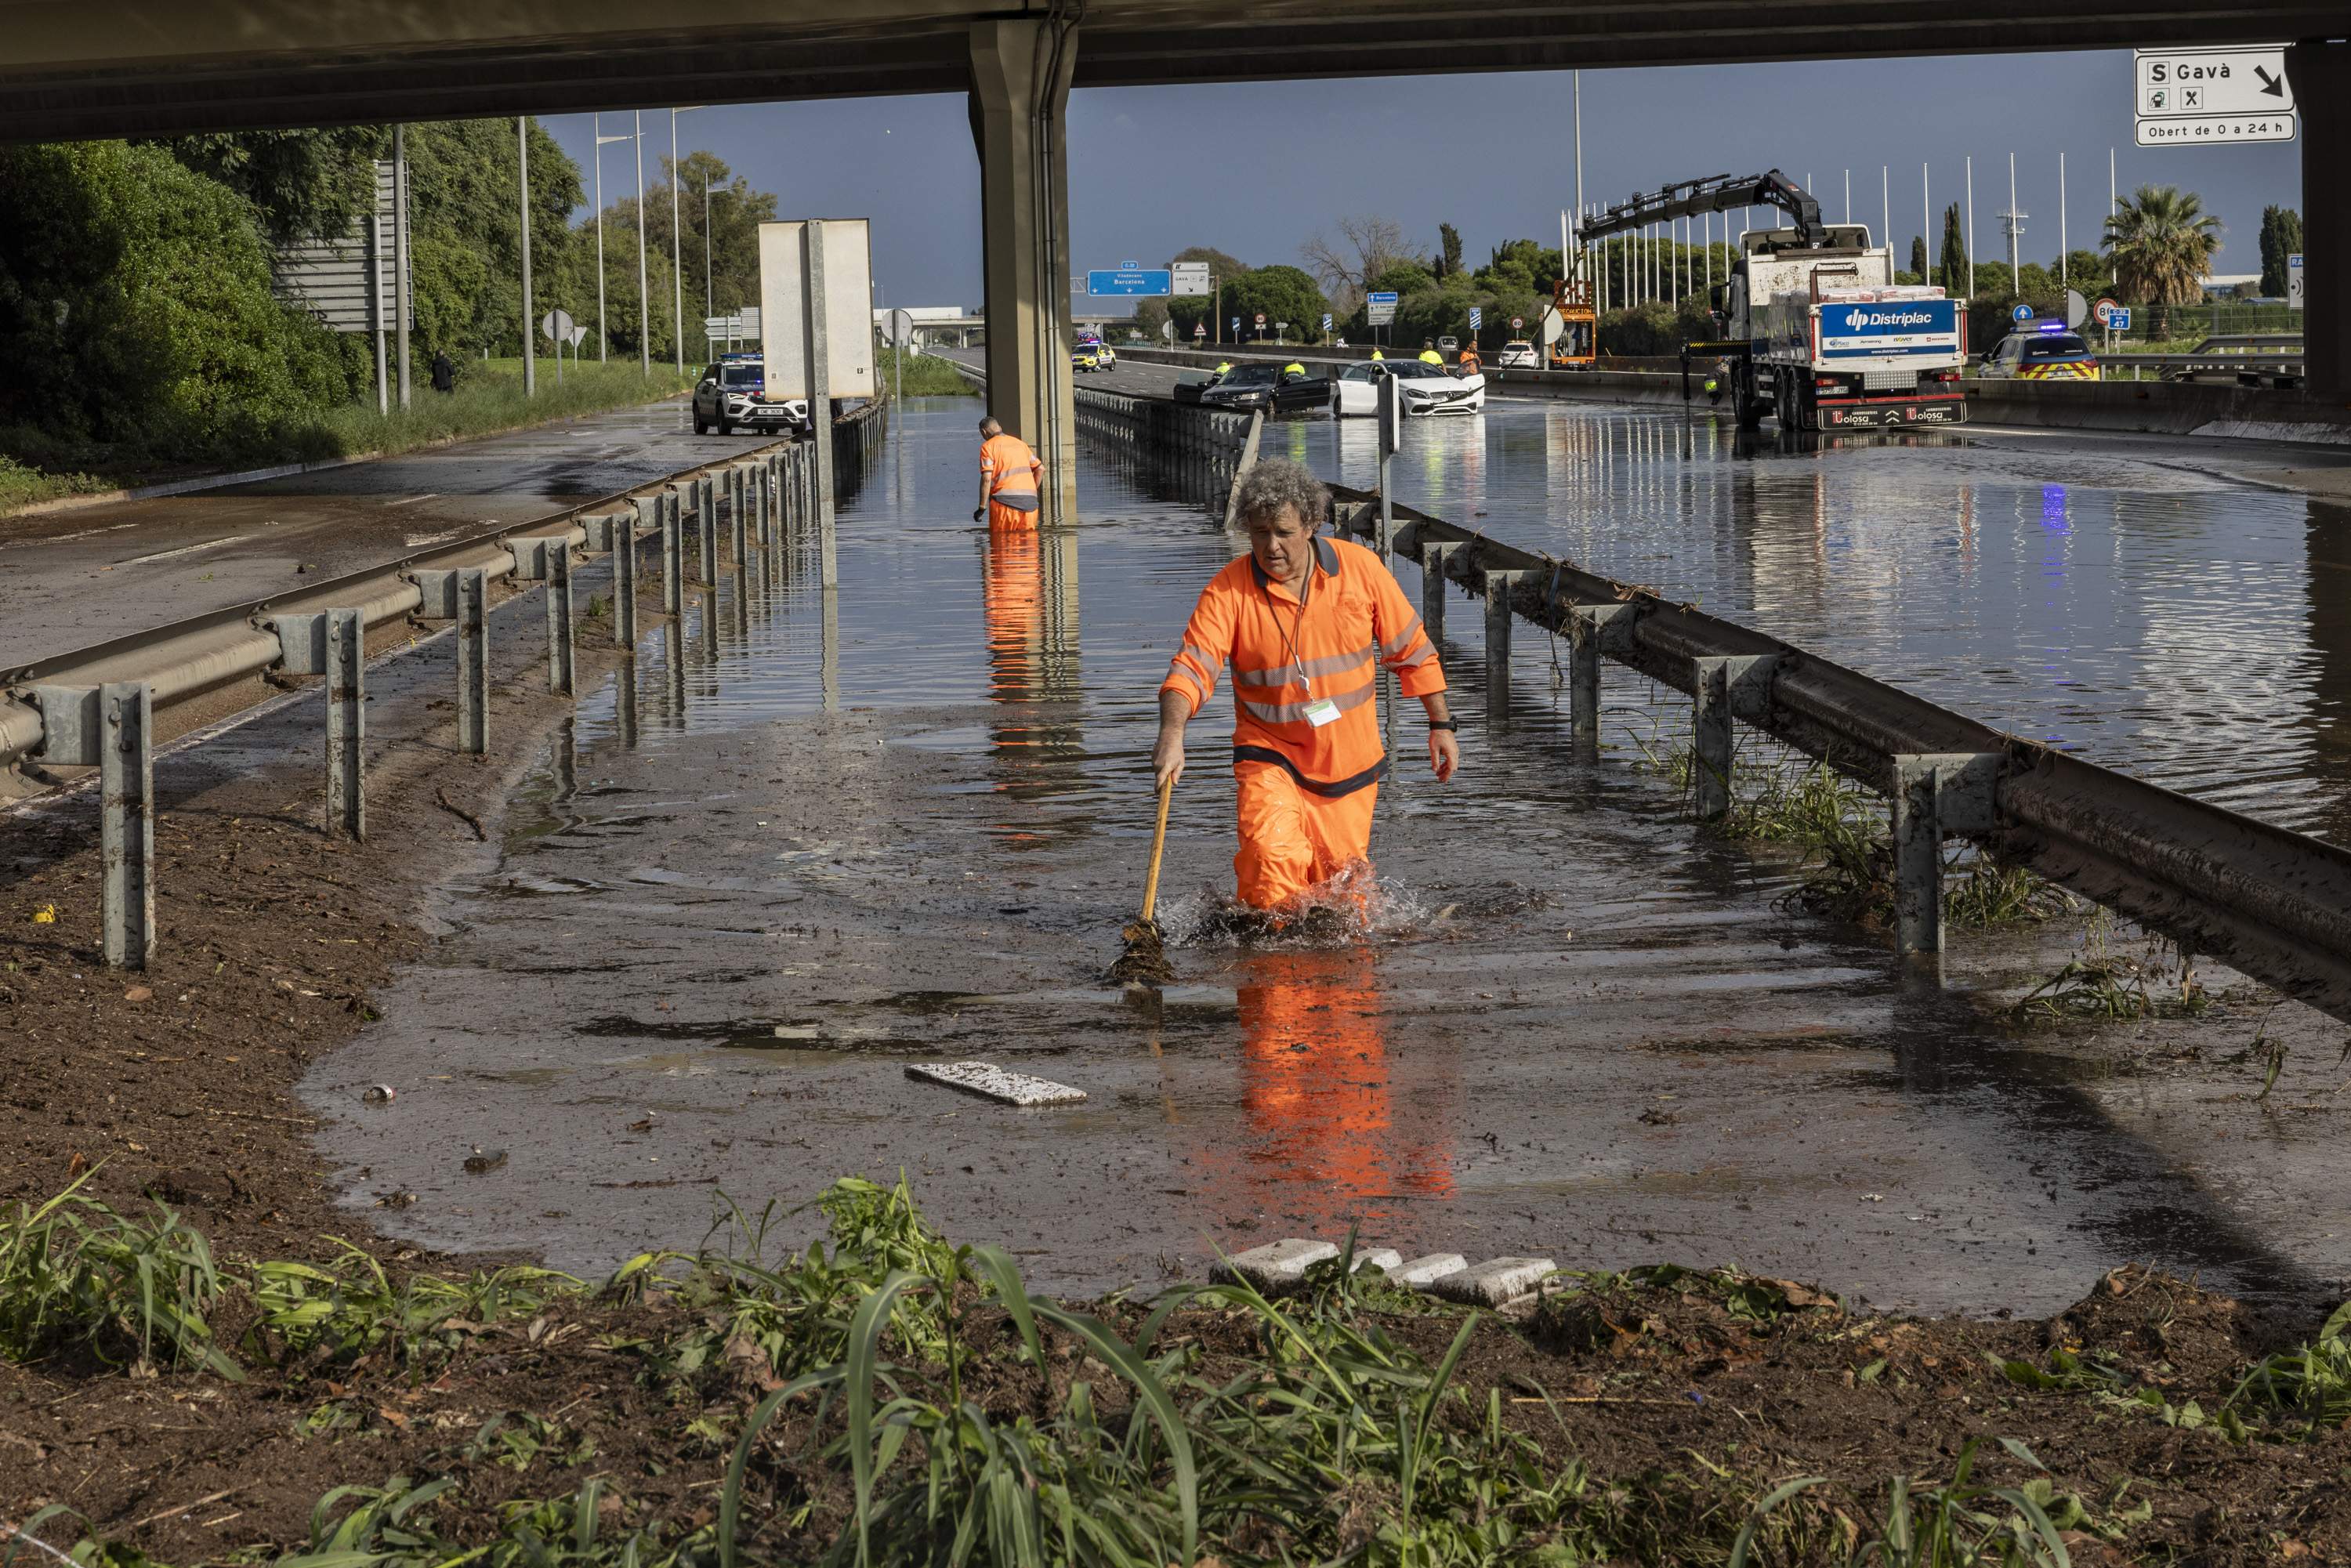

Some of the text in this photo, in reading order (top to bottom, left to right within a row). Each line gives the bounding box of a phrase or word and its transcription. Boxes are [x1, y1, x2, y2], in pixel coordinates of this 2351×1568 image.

[2151, 63, 2230, 82] S Gavà
[2149, 125, 2188, 137] Obert
[2195, 125, 2210, 136] de
[2233, 125, 2241, 134] a
[2248, 123, 2267, 134] 24
[2275, 122, 2283, 132] h
[1870, 312, 1932, 328] Distriplac
